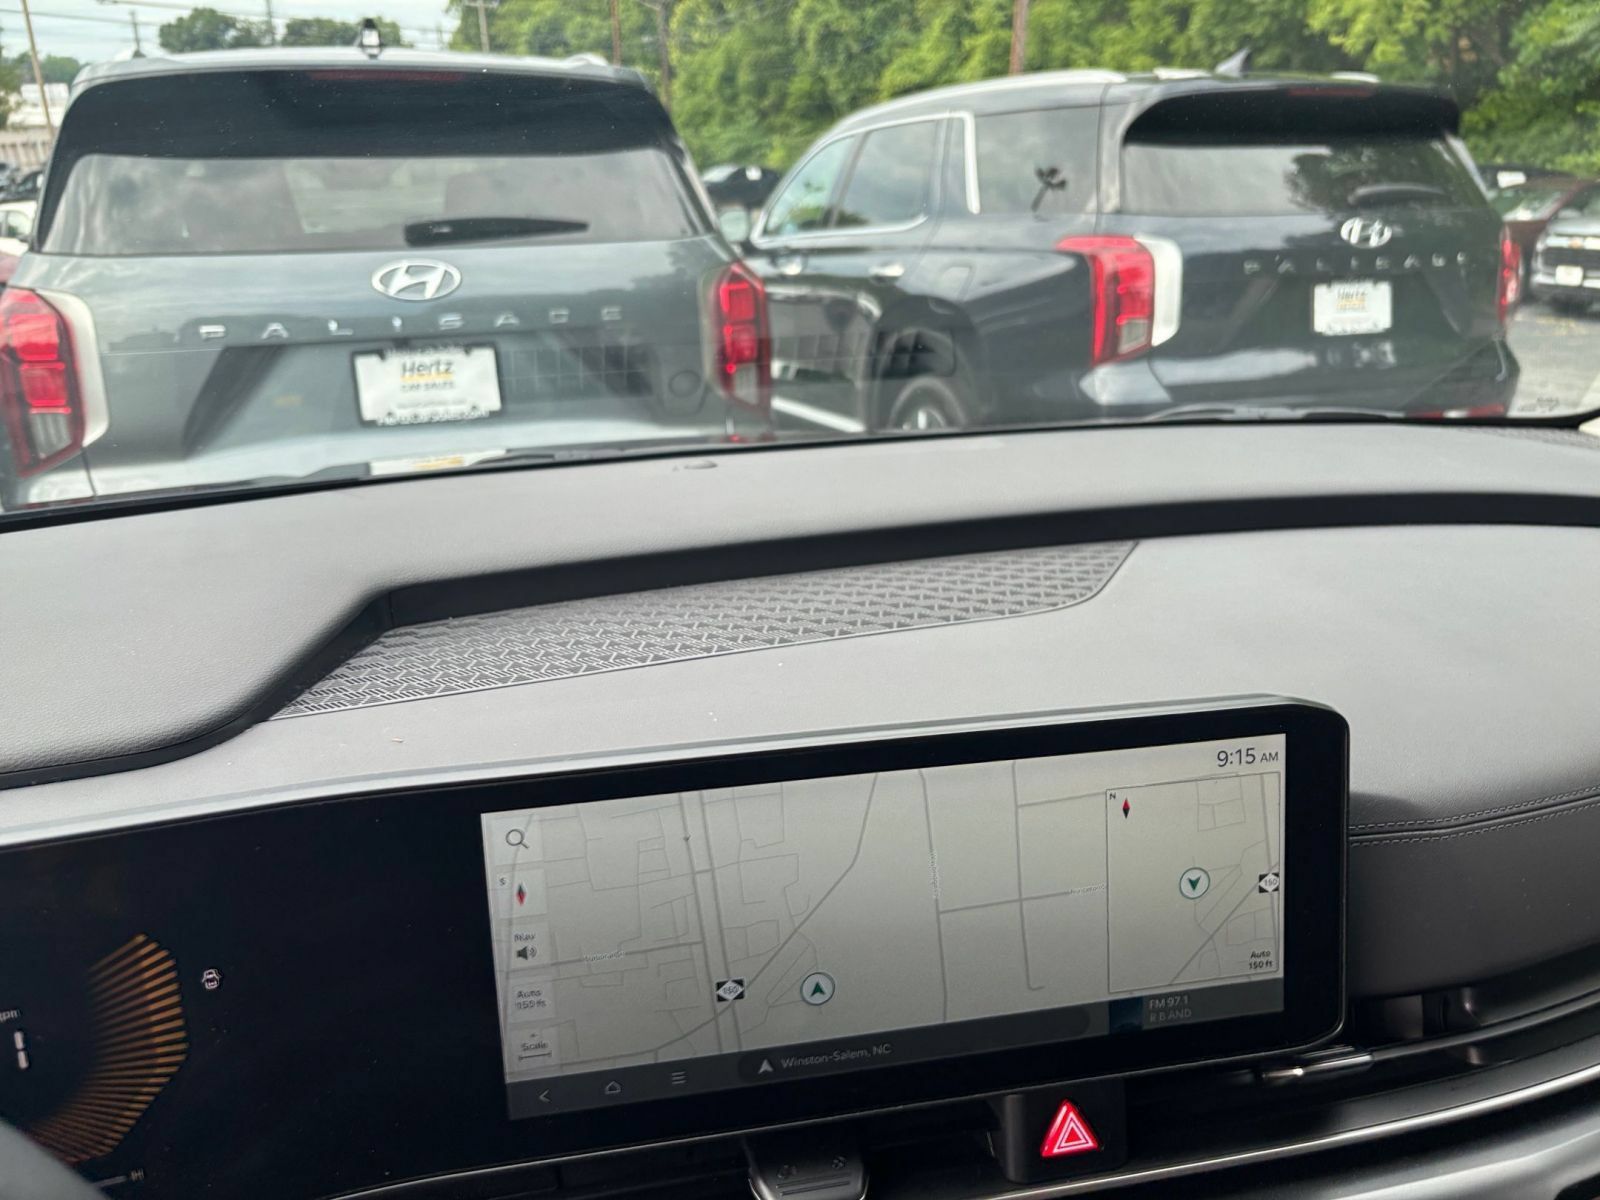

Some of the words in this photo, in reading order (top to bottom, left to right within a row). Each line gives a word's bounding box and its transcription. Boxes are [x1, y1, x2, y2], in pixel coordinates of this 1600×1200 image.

[401, 359, 454, 377] Hertz
[1217, 747, 1256, 767] 9:15
[1260, 751, 1279, 762] AM
[1149, 998, 1166, 1010] FM
[872, 1043, 892, 1056] NC
